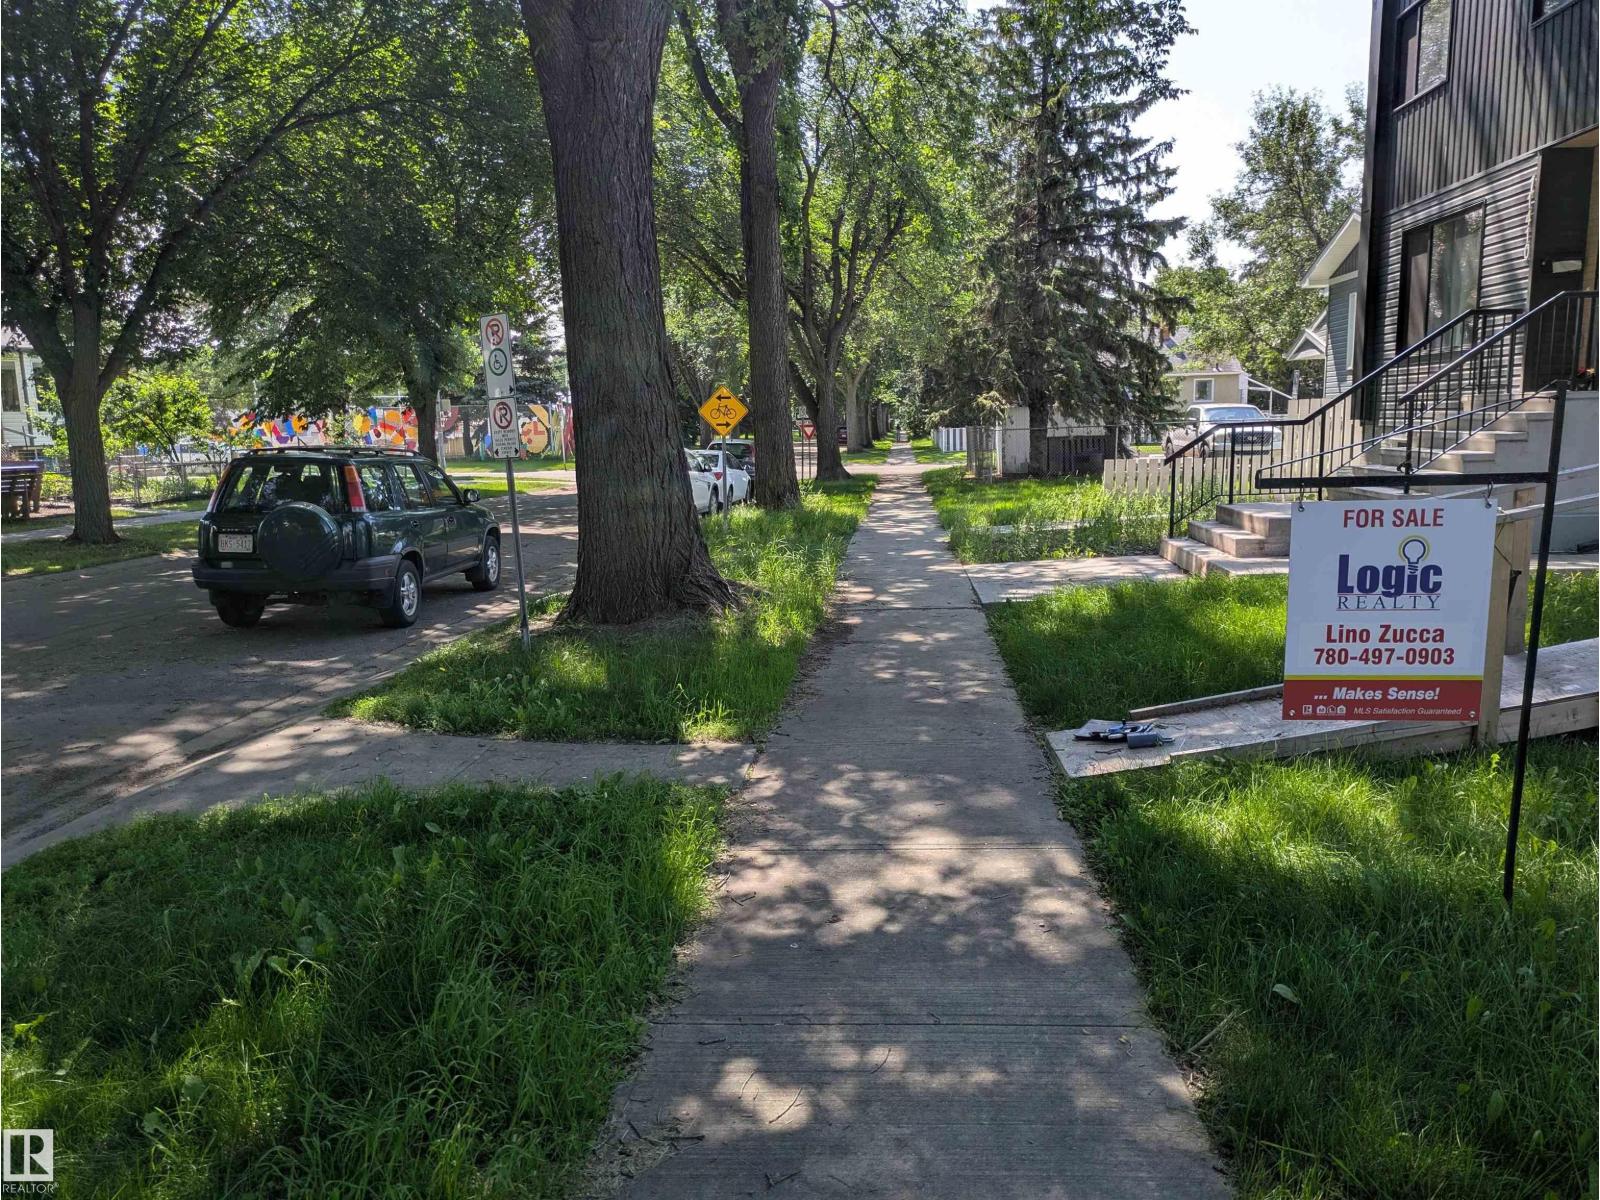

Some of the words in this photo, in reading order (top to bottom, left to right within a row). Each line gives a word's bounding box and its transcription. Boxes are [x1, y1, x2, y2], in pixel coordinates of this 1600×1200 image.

[1343, 509, 1385, 528] FOR
[1392, 508, 1445, 527] SALE
[1337, 553, 1443, 598] Logic
[1337, 595, 1441, 609] REALTY
[1326, 624, 1371, 643] Lino
[1378, 624, 1445, 643] Zucca
[1313, 647, 1455, 665] 780-497-0903
[1333, 687, 1382, 700] Makes
[1387, 687, 1440, 700] Sense!
[1353, 707, 1371, 715] MLS
[1373, 707, 1416, 715] Satisfaction
[1417, 707, 1463, 715] Guaranteed
